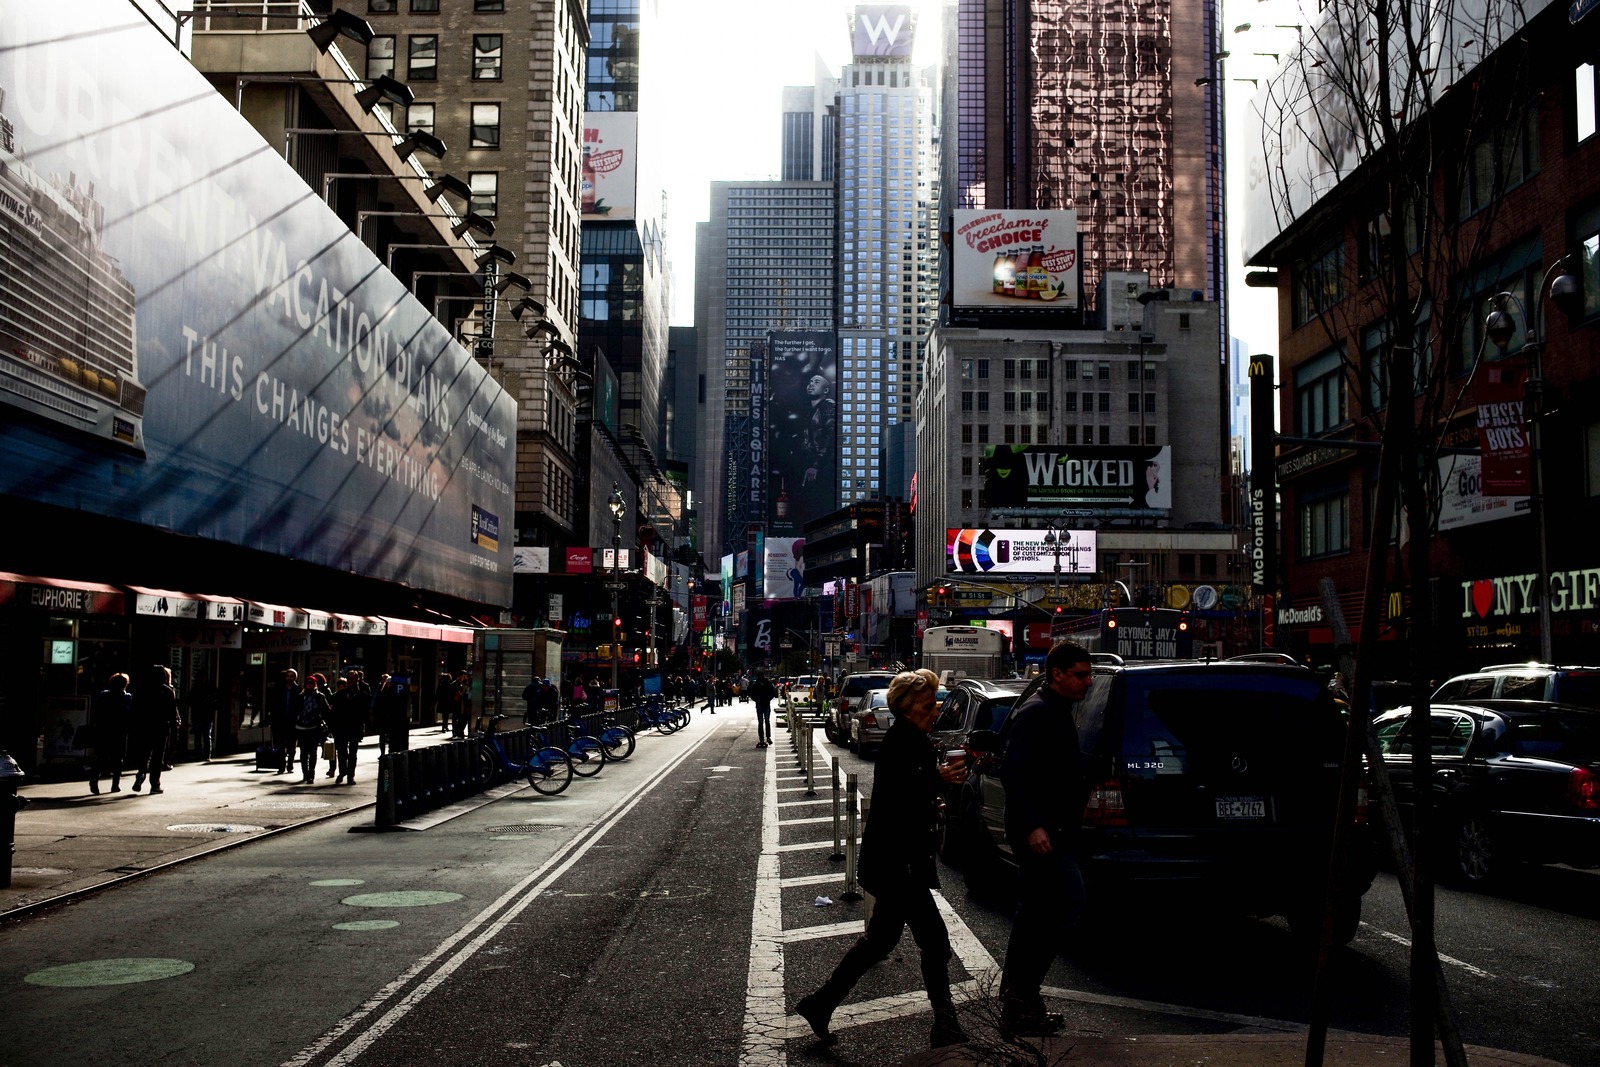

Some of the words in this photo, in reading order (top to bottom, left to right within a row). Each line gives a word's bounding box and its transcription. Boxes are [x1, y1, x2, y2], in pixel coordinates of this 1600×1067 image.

[860, 14, 906, 46] W
[957, 213, 1002, 235] CELEBRATE
[966, 219, 1034, 249] freedom
[1035, 219, 1049, 231] of
[977, 229, 1042, 253] CHOICE
[1041, 258, 1057, 268] BEST
[1056, 253, 1074, 266] STUFF
[249, 213, 389, 388] VACATION
[182, 325, 244, 402] THIS
[256, 371, 350, 456] CHANGES
[750, 358, 763, 420] TIMES
[1476, 400, 1525, 428] JERSEY
[1485, 426, 1525, 451] BOYS
[750, 426, 763, 502] SQUARE
[1278, 459, 1293, 477] TIMES
[1292, 451, 1313, 472] SQUARE
[1253, 488, 1265, 587] McDonald's
[31, 587, 82, 610] EUPHORIE
[217, 604, 226, 618] Lee
[848, 586, 856, 615] Twizzlers
[1461, 581, 1472, 619] I
[1278, 605, 1322, 625] McDonald's
[1156, 627, 1170, 640] JAY
[1172, 628, 1177, 641] Z
[1117, 639, 1132, 657] ON
[1134, 640, 1154, 658] THE
[1155, 641, 1177, 658] RUN
[396, 684, 404, 694] P
[1219, 802, 1235, 816] BEE
